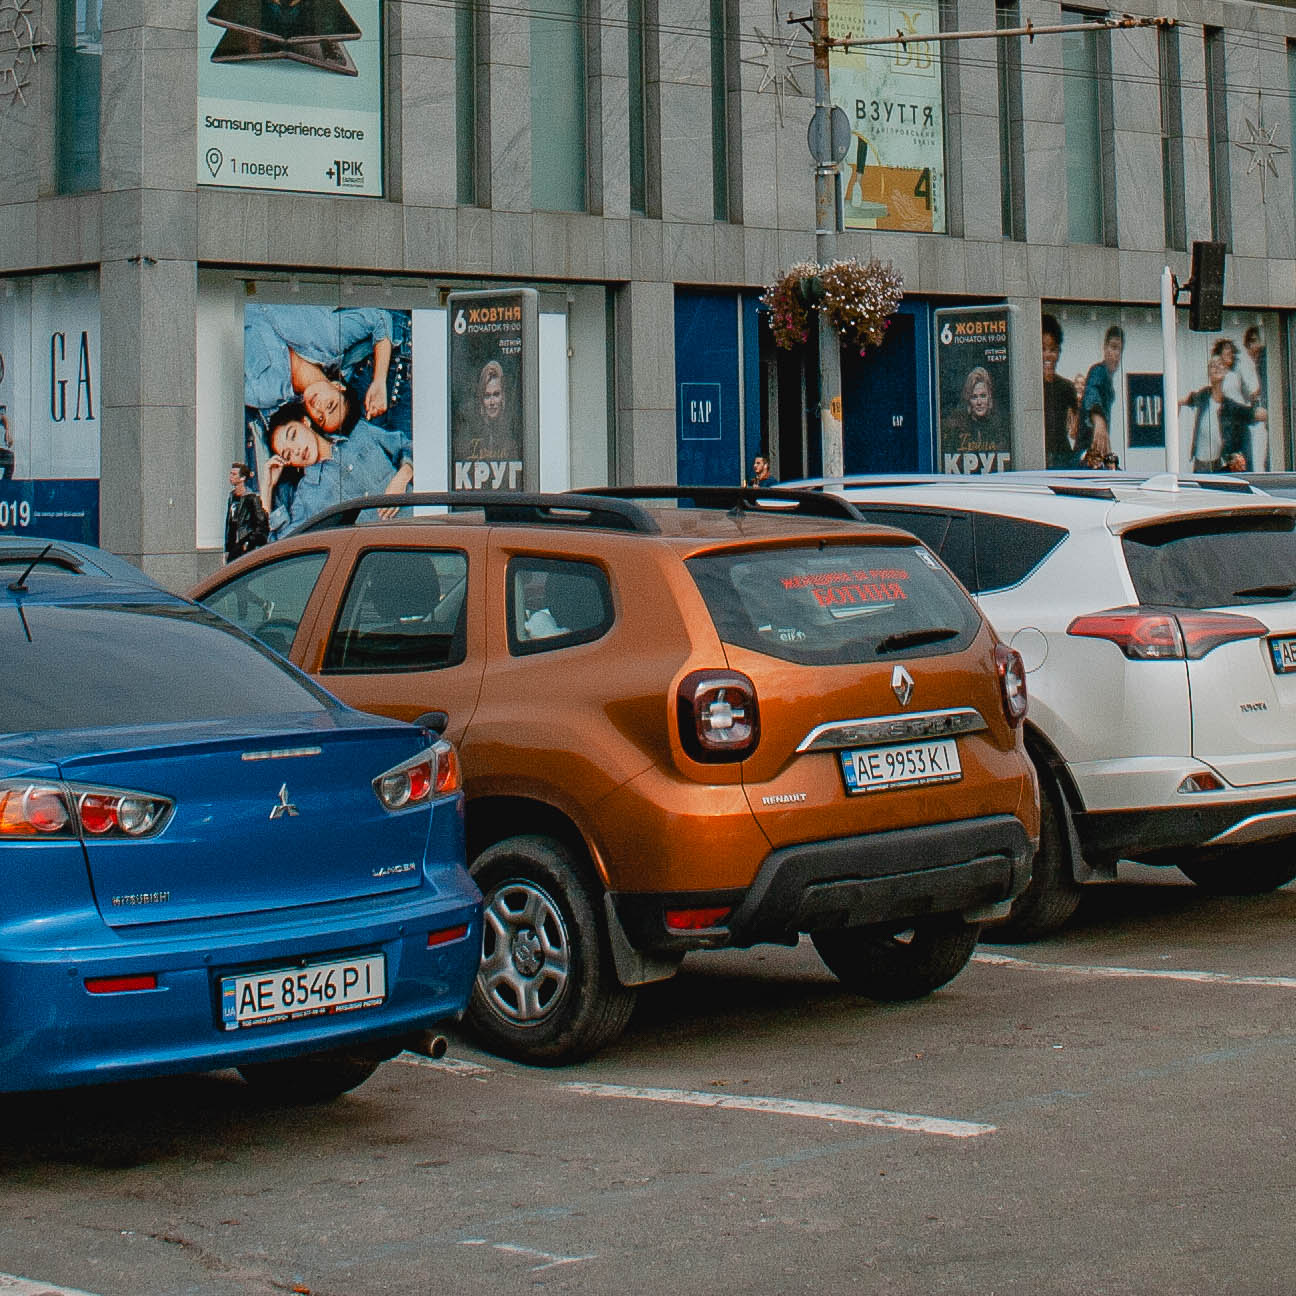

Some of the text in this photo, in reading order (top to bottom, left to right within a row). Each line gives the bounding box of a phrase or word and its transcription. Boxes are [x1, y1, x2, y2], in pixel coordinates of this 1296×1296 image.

[856, 99, 933, 126] ВЗУТТЯ
[205, 115, 364, 140] Samsung Experience Store
[231, 158, 289, 180] 1 поверх
[342, 161, 364, 177] РІК
[914, 167, 930, 210] 4
[455, 306, 521, 334] 6 ЖОВТНЯ
[468, 324, 501, 333] ПОЧАТОК
[941, 320, 1006, 345] 6 ЖОВТНЯ
[954, 334, 1006, 344] ПОЧАТОК 19:00
[690, 400, 712, 423] GAP
[892, 415, 903, 427] GAP
[1137, 395, 1161, 425] GAP
[456, 461, 522, 489] КРУГ
[944, 453, 1010, 475] КРУГ
[811, 582, 908, 606] БОГИНЯ
[858, 745, 950, 782] AE 9953 KI
[762, 794, 806, 805] RENAULT
[111, 891, 170, 907] MITSUBISHI
[239, 962, 371, 1015] AE 8546 PI
[223, 1007, 236, 1017] UA
